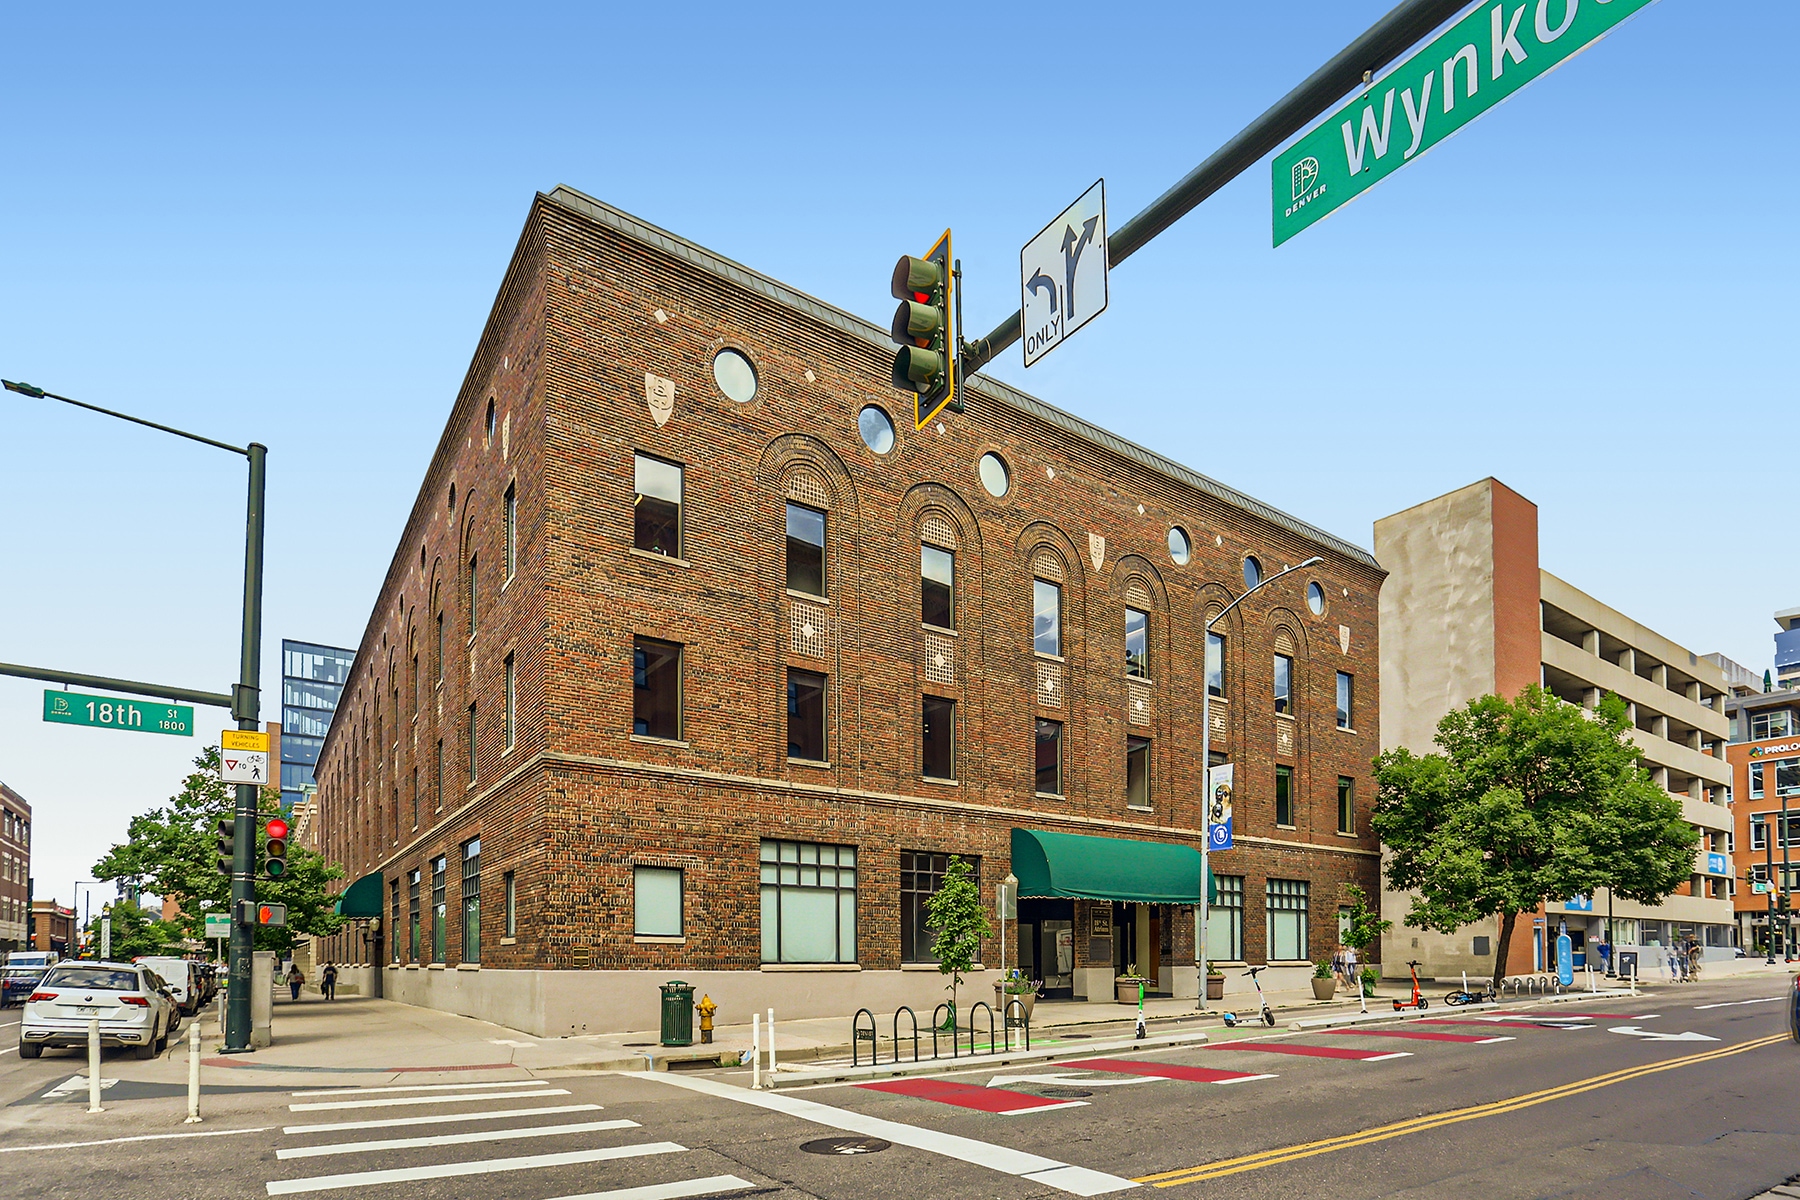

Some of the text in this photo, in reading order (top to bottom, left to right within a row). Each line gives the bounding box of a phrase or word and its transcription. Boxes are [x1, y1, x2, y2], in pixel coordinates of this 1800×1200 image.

[1341, 0, 1614, 177] Wynko
[1285, 183, 1327, 218] DENVER
[1026, 314, 1060, 356] ONLY
[85, 701, 178, 727] 18th St
[158, 720, 186, 731] 1800
[232, 733, 260, 741] TURNING
[231, 740, 260, 749] VEHICLES
[1764, 742, 1800, 755] PROLO
[238, 762, 247, 770] TO
